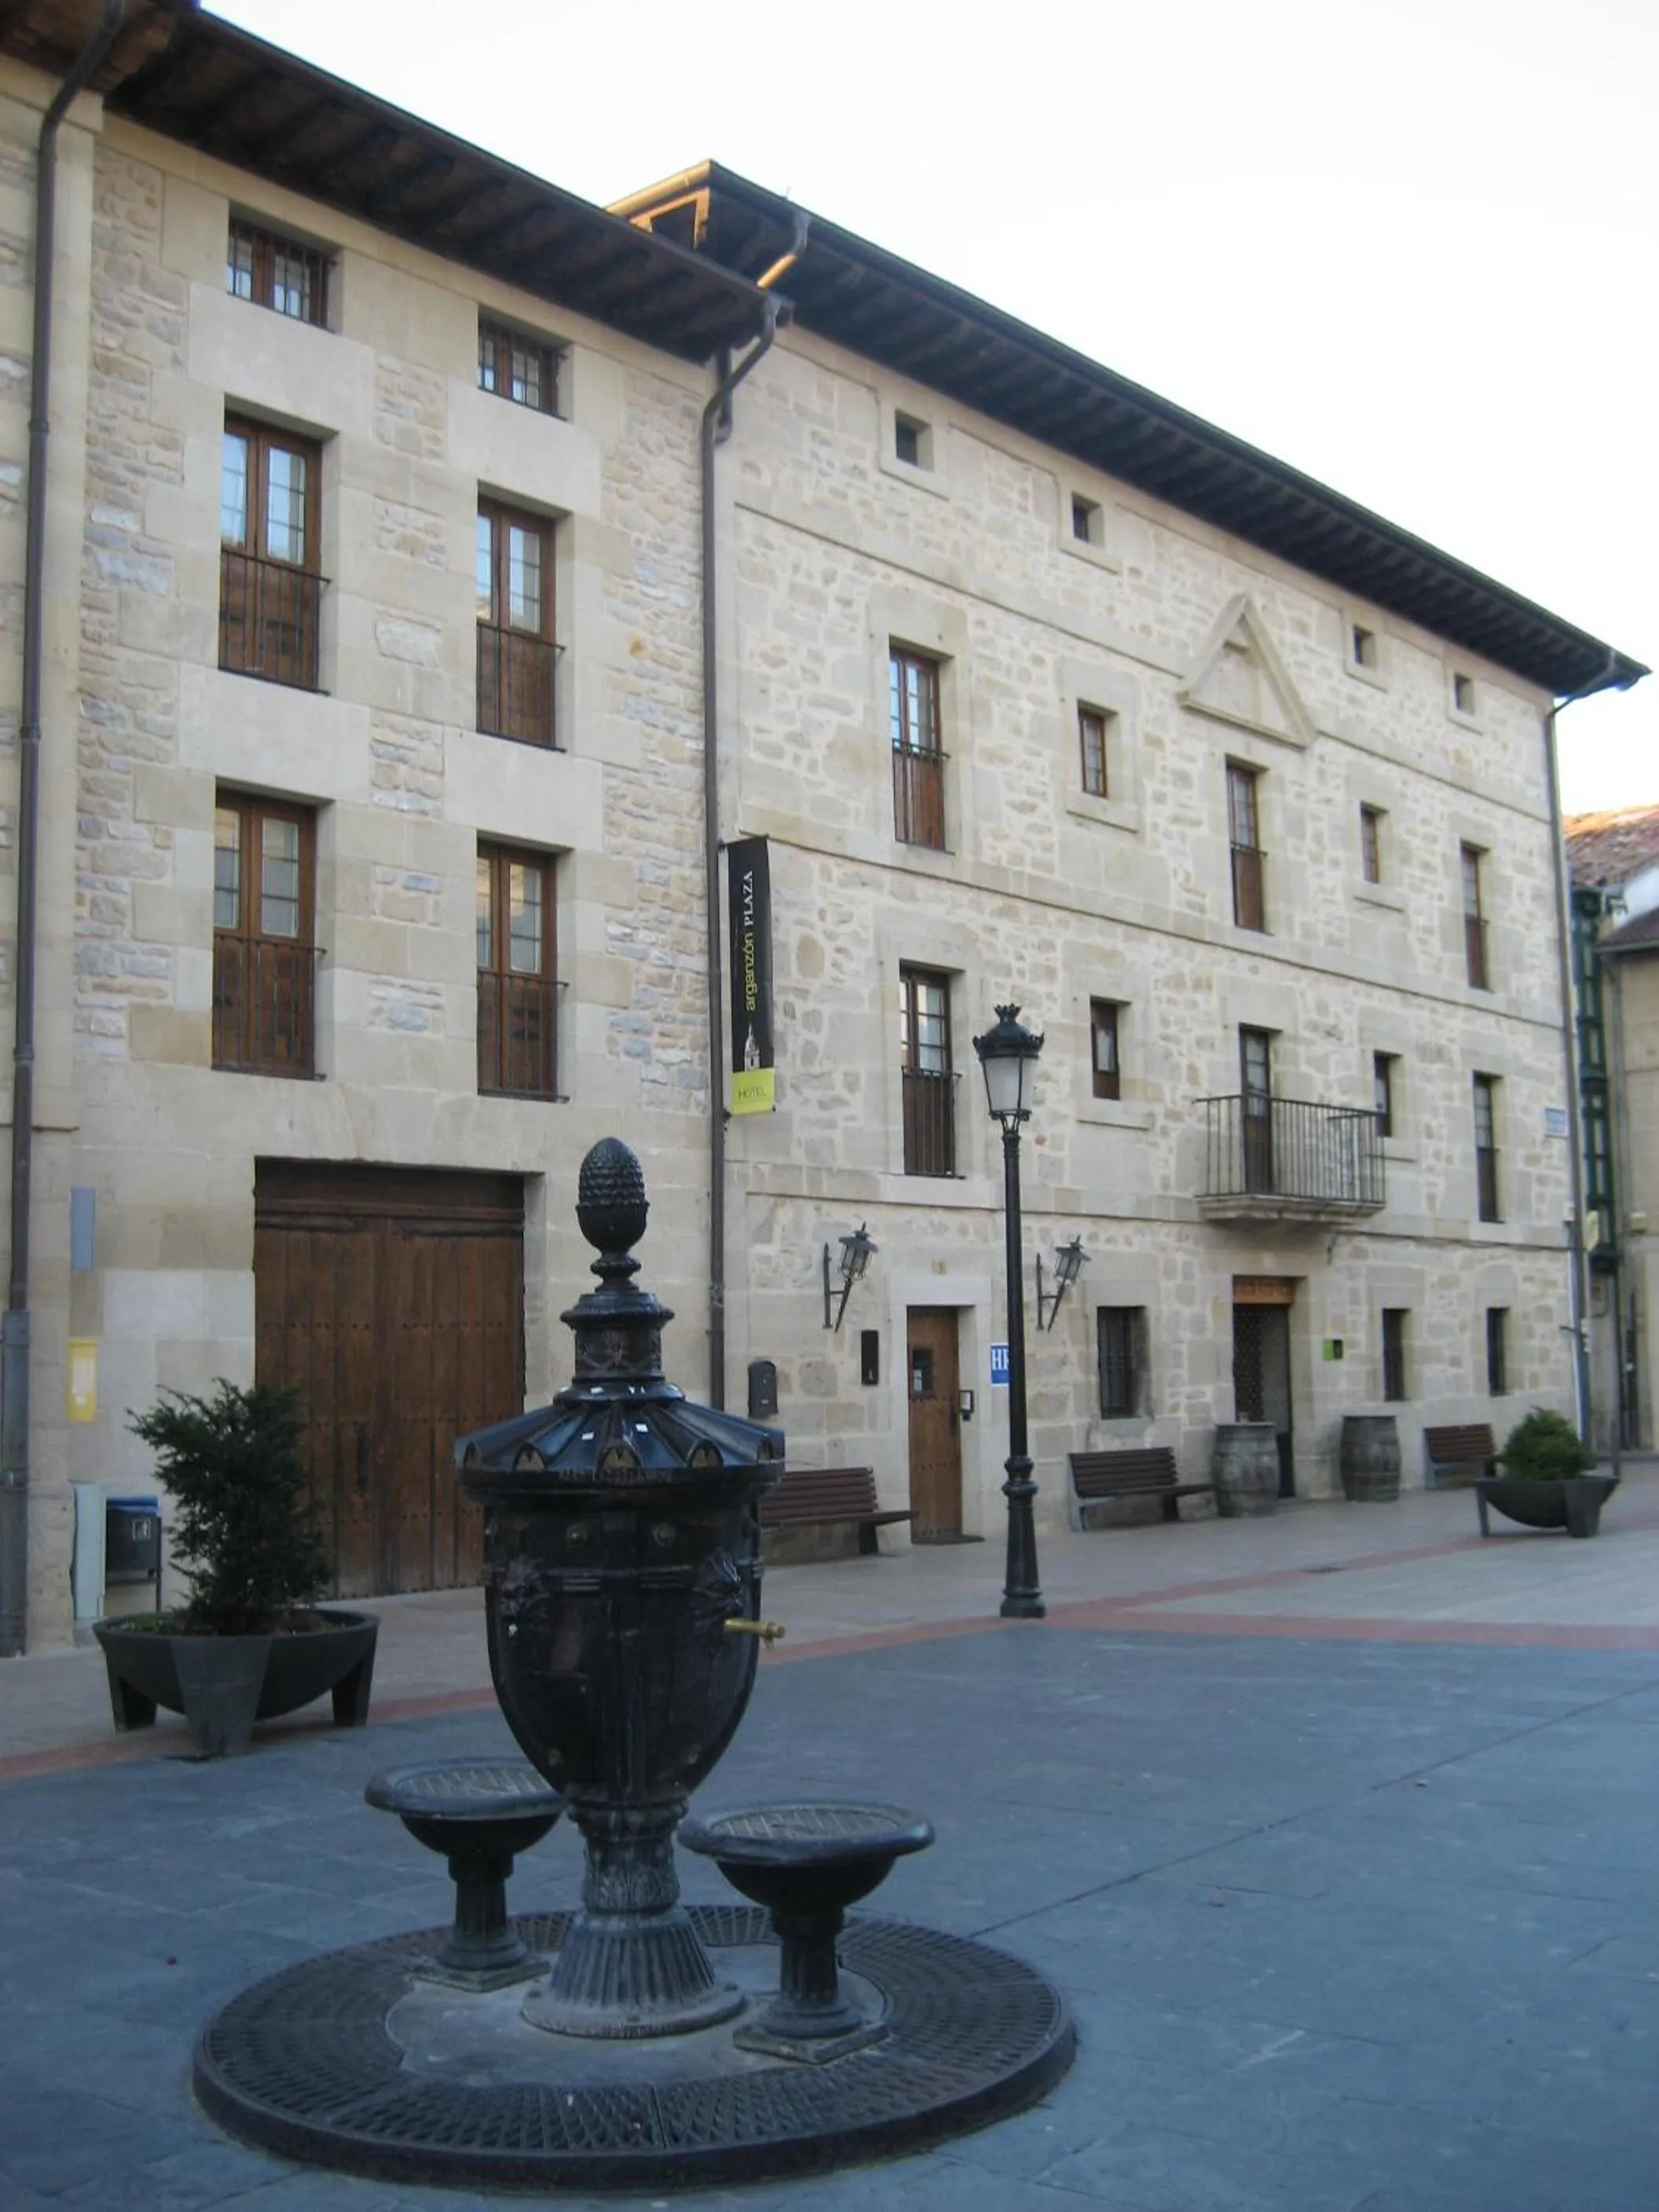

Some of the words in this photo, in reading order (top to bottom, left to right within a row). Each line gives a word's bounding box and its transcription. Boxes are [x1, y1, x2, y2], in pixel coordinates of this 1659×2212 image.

[743, 870, 754, 926] PLAZA
[742, 932, 758, 1013] arganzón
[738, 1086, 767, 1098] HOTEL
